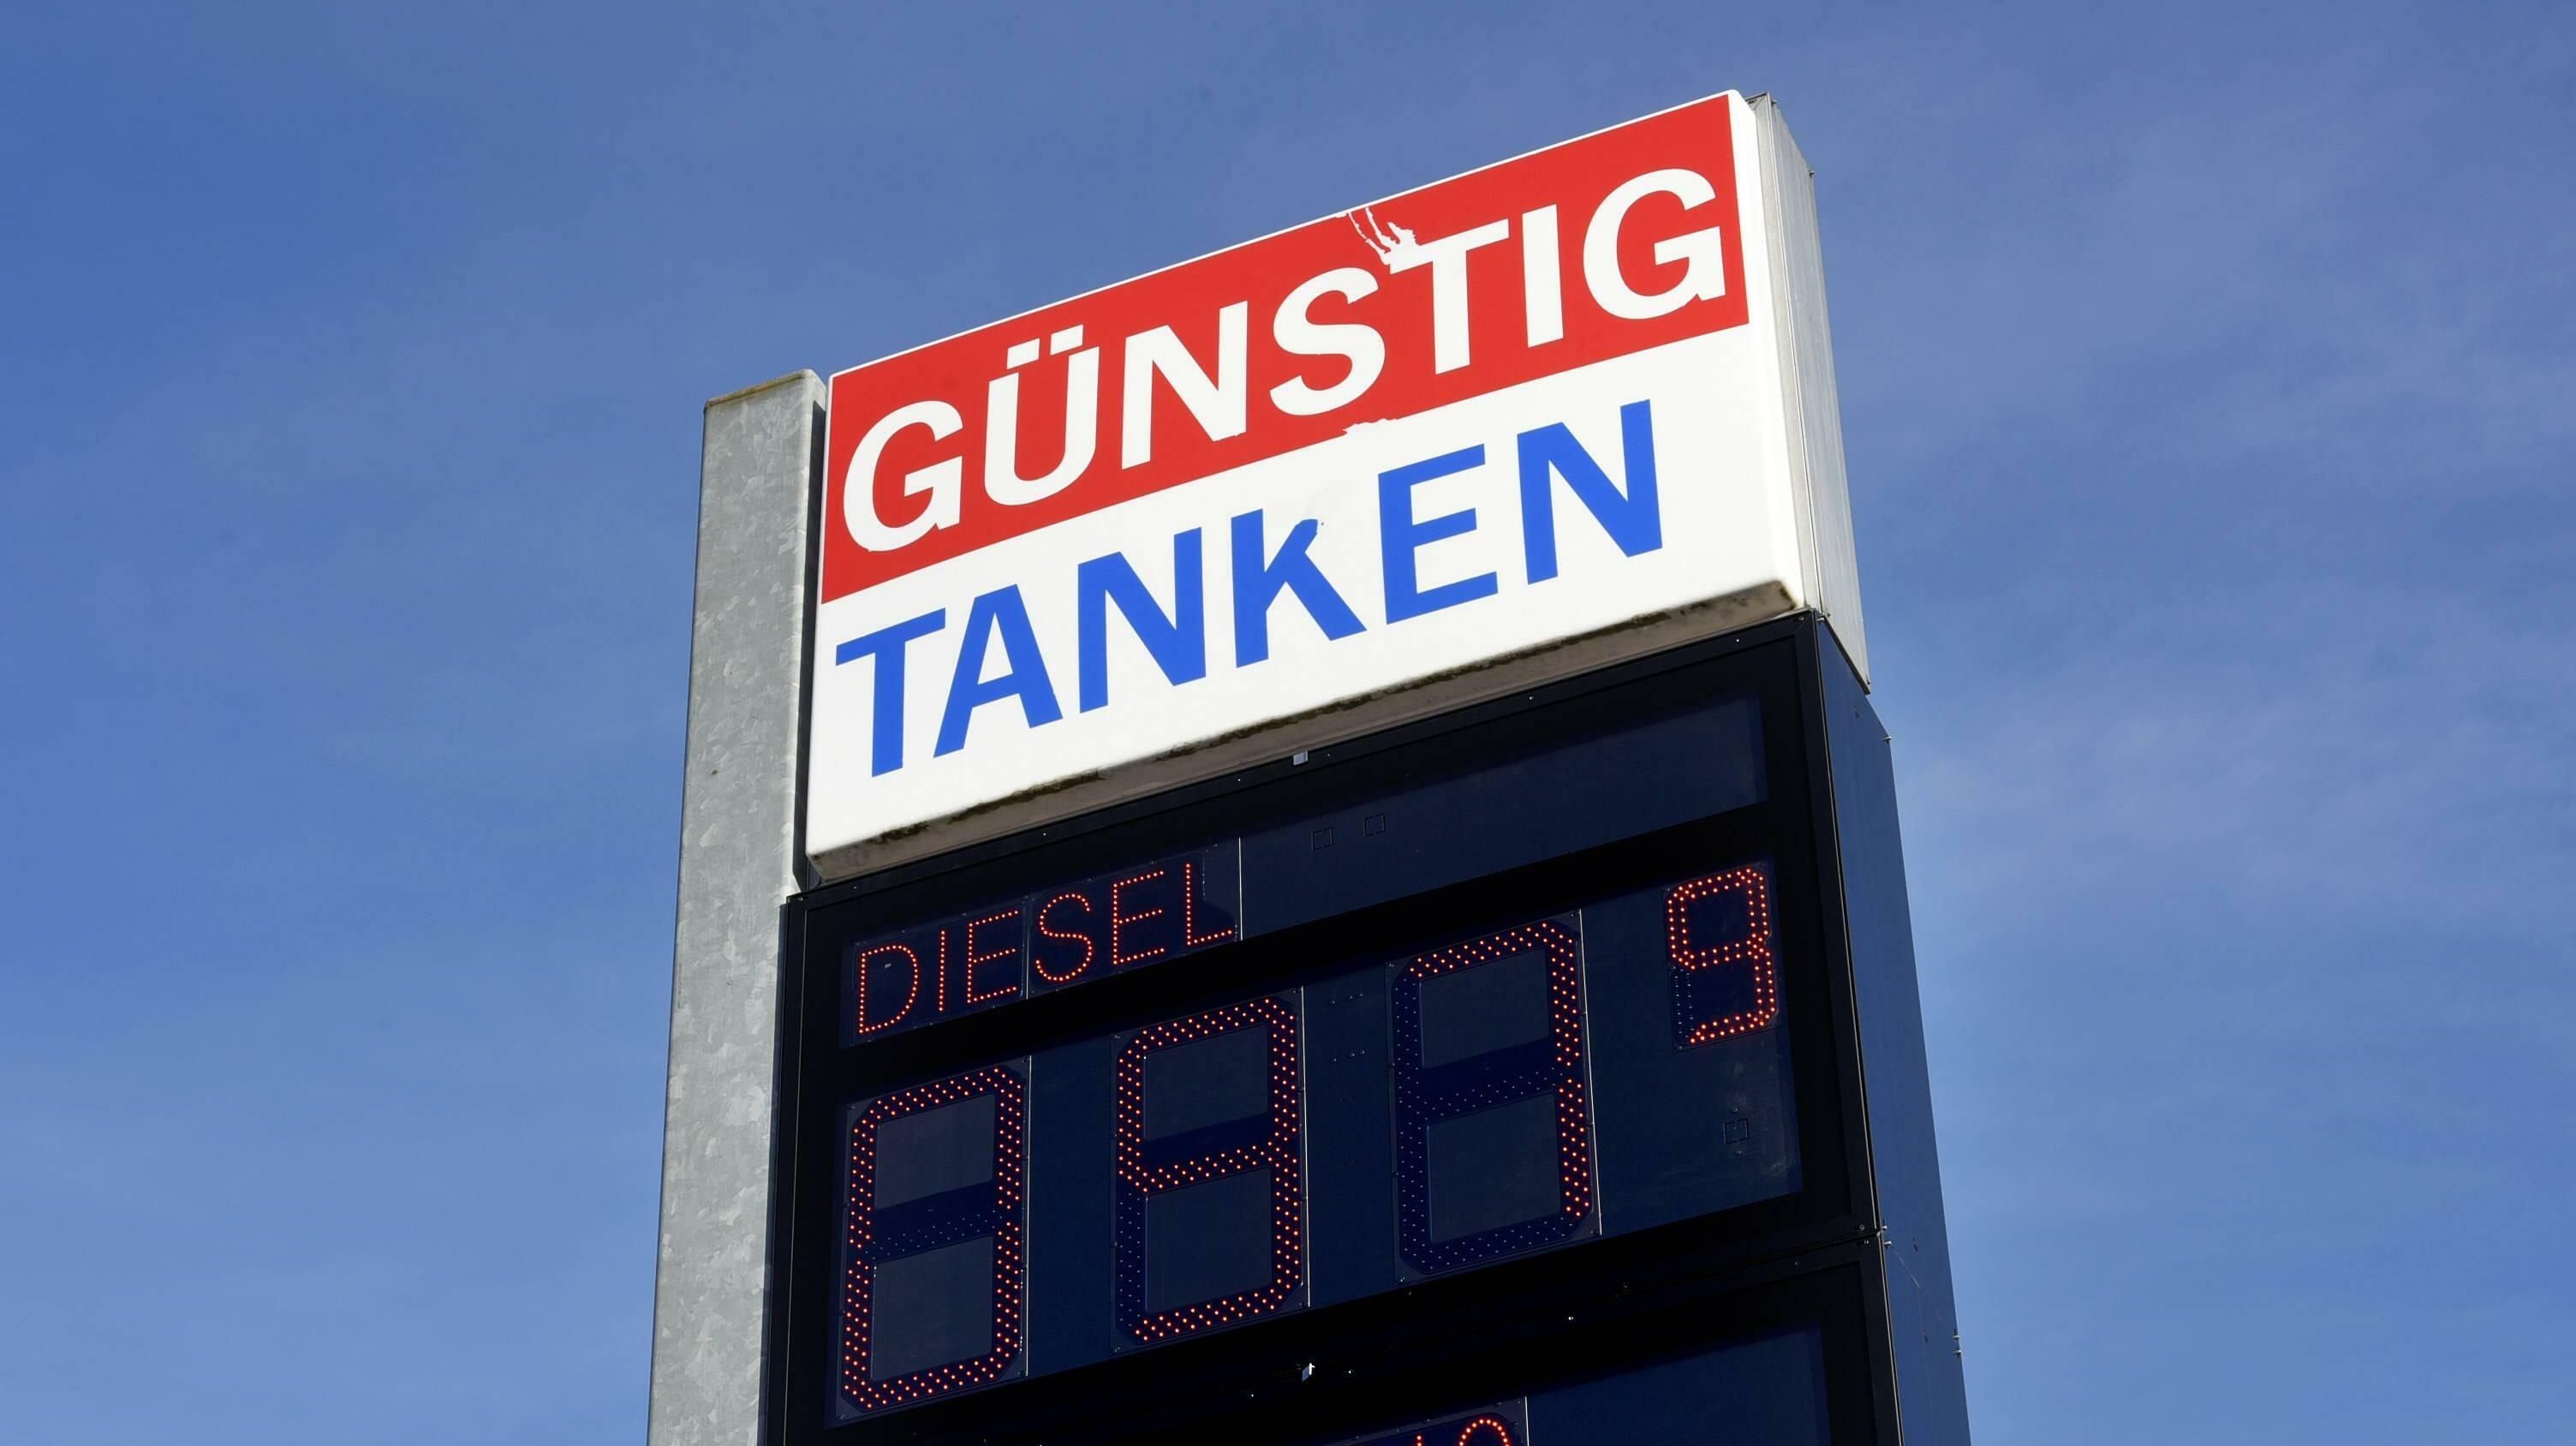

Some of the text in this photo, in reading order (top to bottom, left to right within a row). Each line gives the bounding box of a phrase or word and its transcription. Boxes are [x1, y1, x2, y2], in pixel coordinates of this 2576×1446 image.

[844, 168, 1726, 552] GÜNSTIG
[836, 400, 1662, 777] TANKEN
[858, 862, 1233, 1034] DIESEL
